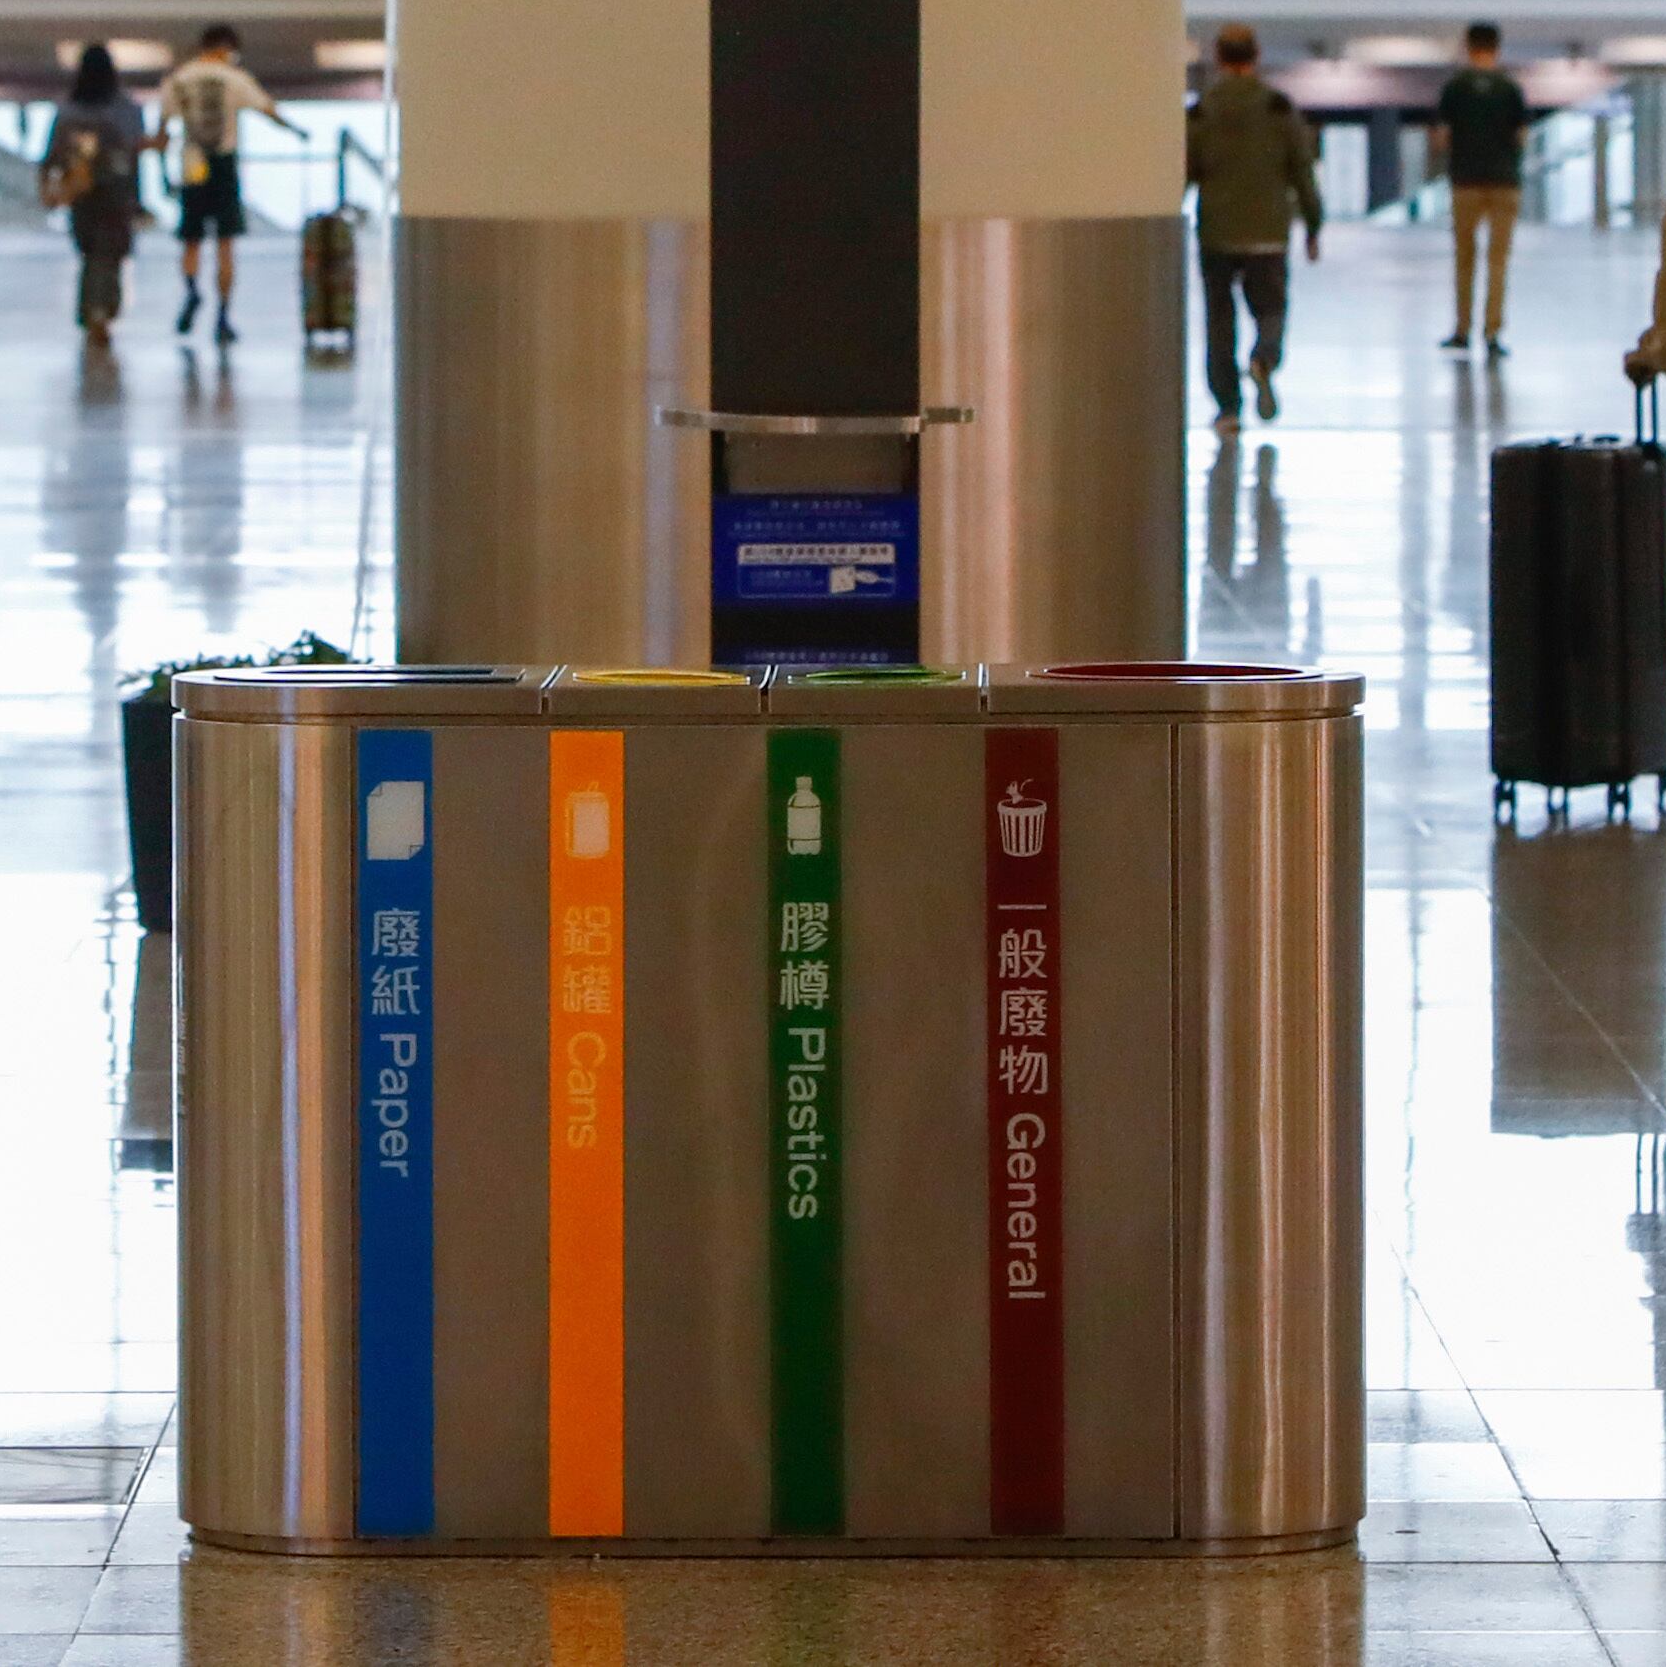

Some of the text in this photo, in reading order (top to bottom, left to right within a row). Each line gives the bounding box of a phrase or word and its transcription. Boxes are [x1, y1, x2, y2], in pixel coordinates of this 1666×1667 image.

[372, 908, 420, 1177] 廢紙 Paper
[563, 908, 611, 1148] 鋁罐 Cans
[780, 903, 829, 1219] 膠樽 Plastics
[998, 905, 1047, 1298] 一般廢物 General
